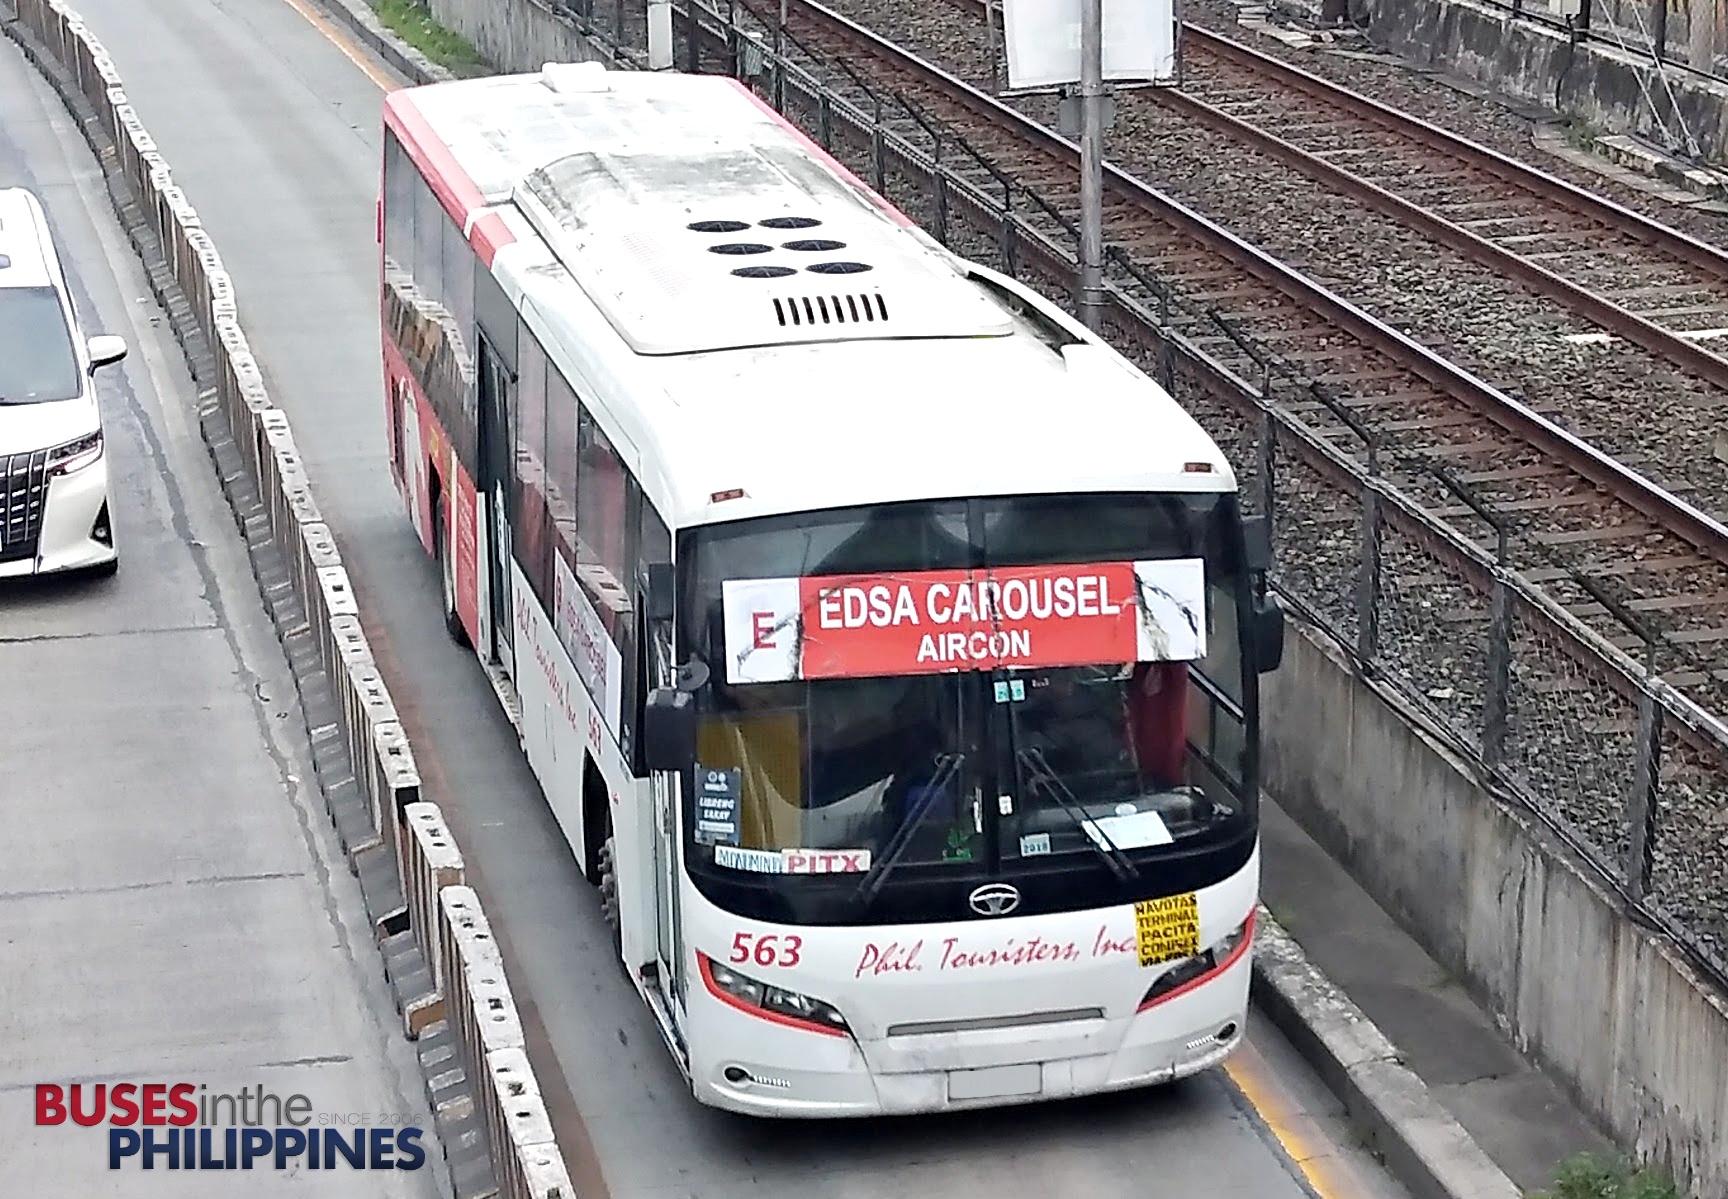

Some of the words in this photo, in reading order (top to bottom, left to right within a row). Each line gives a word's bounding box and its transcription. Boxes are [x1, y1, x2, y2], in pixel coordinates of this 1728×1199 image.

[819, 584, 919, 629] EDSA
[926, 576, 1120, 624] CAROUSEL
[752, 612, 776, 649] E
[916, 629, 1030, 662] AIRCON
[788, 854, 860, 874] PITX
[1141, 922, 1196, 943] PACITA
[730, 933, 802, 967] 563
[855, 939, 923, 978] Phil.
[940, 936, 1081, 970] Touristers,
